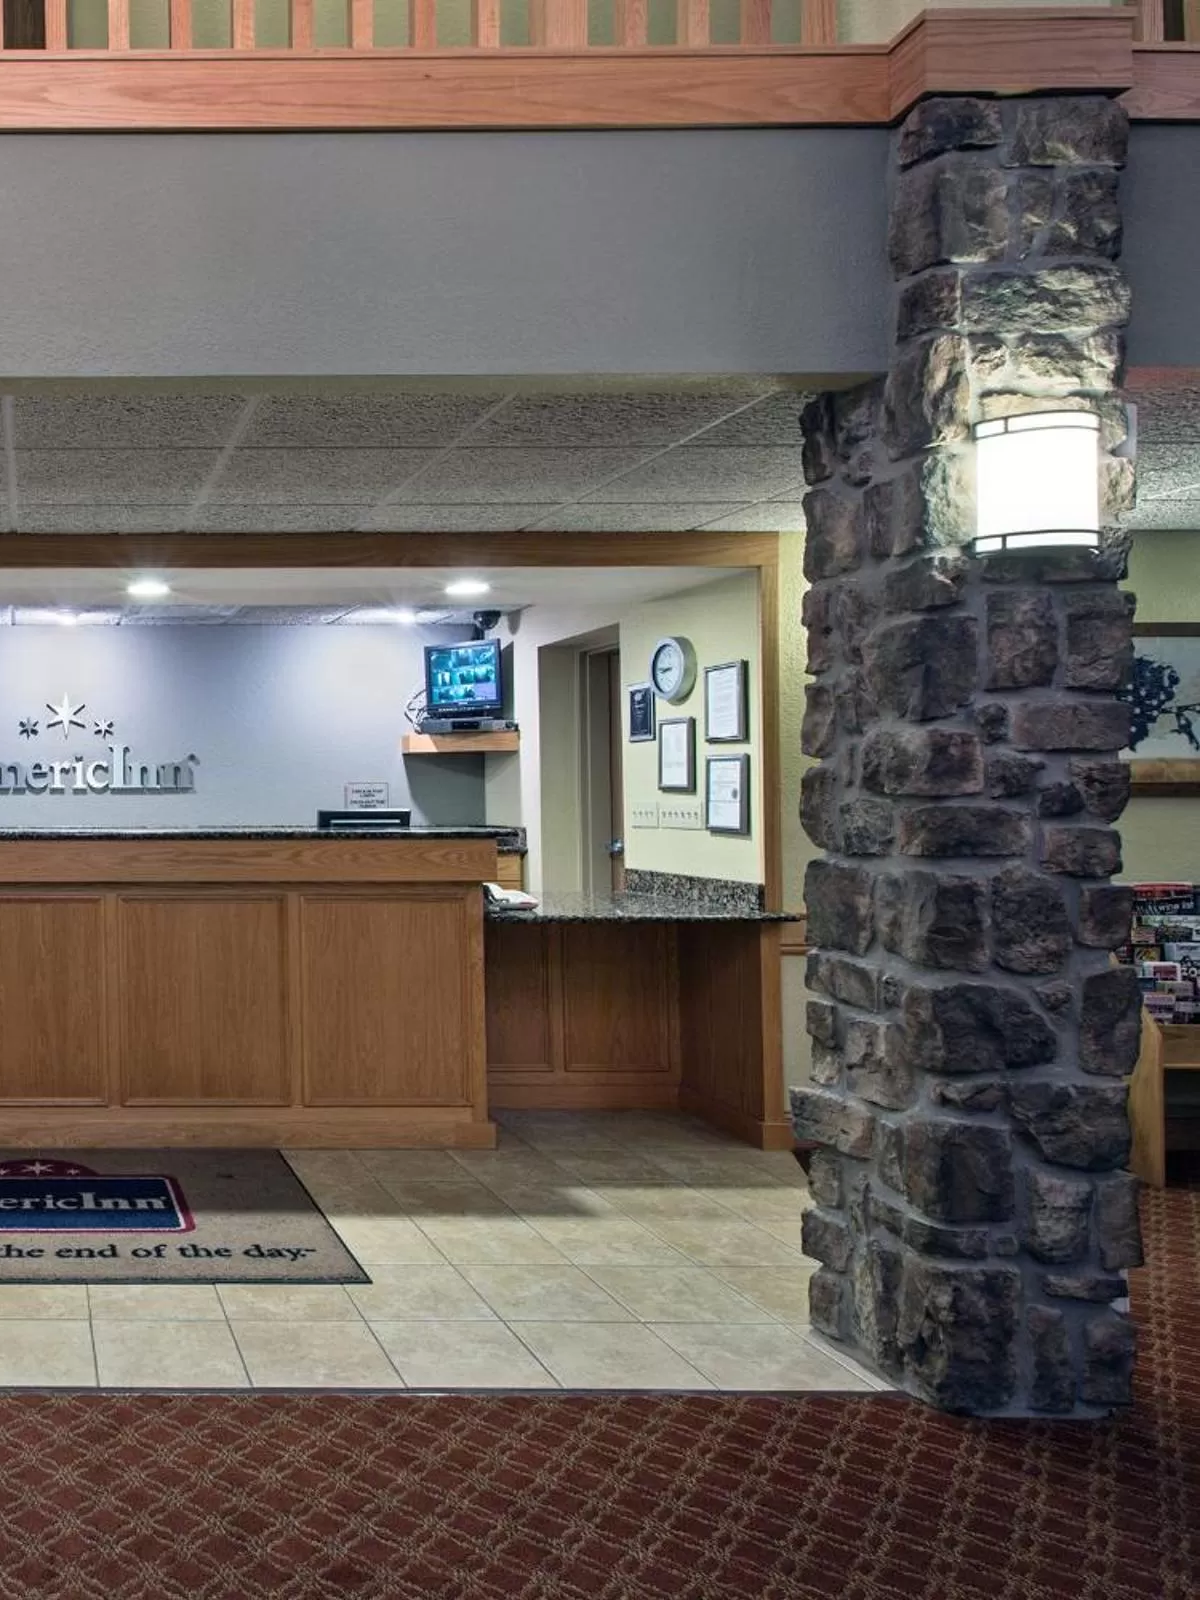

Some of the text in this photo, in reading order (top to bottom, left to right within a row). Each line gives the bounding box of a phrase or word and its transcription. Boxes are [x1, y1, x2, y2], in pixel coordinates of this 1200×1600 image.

[56, 1244, 119, 1258] end
[131, 1244, 167, 1258] of
[179, 1244, 232, 1258] the
